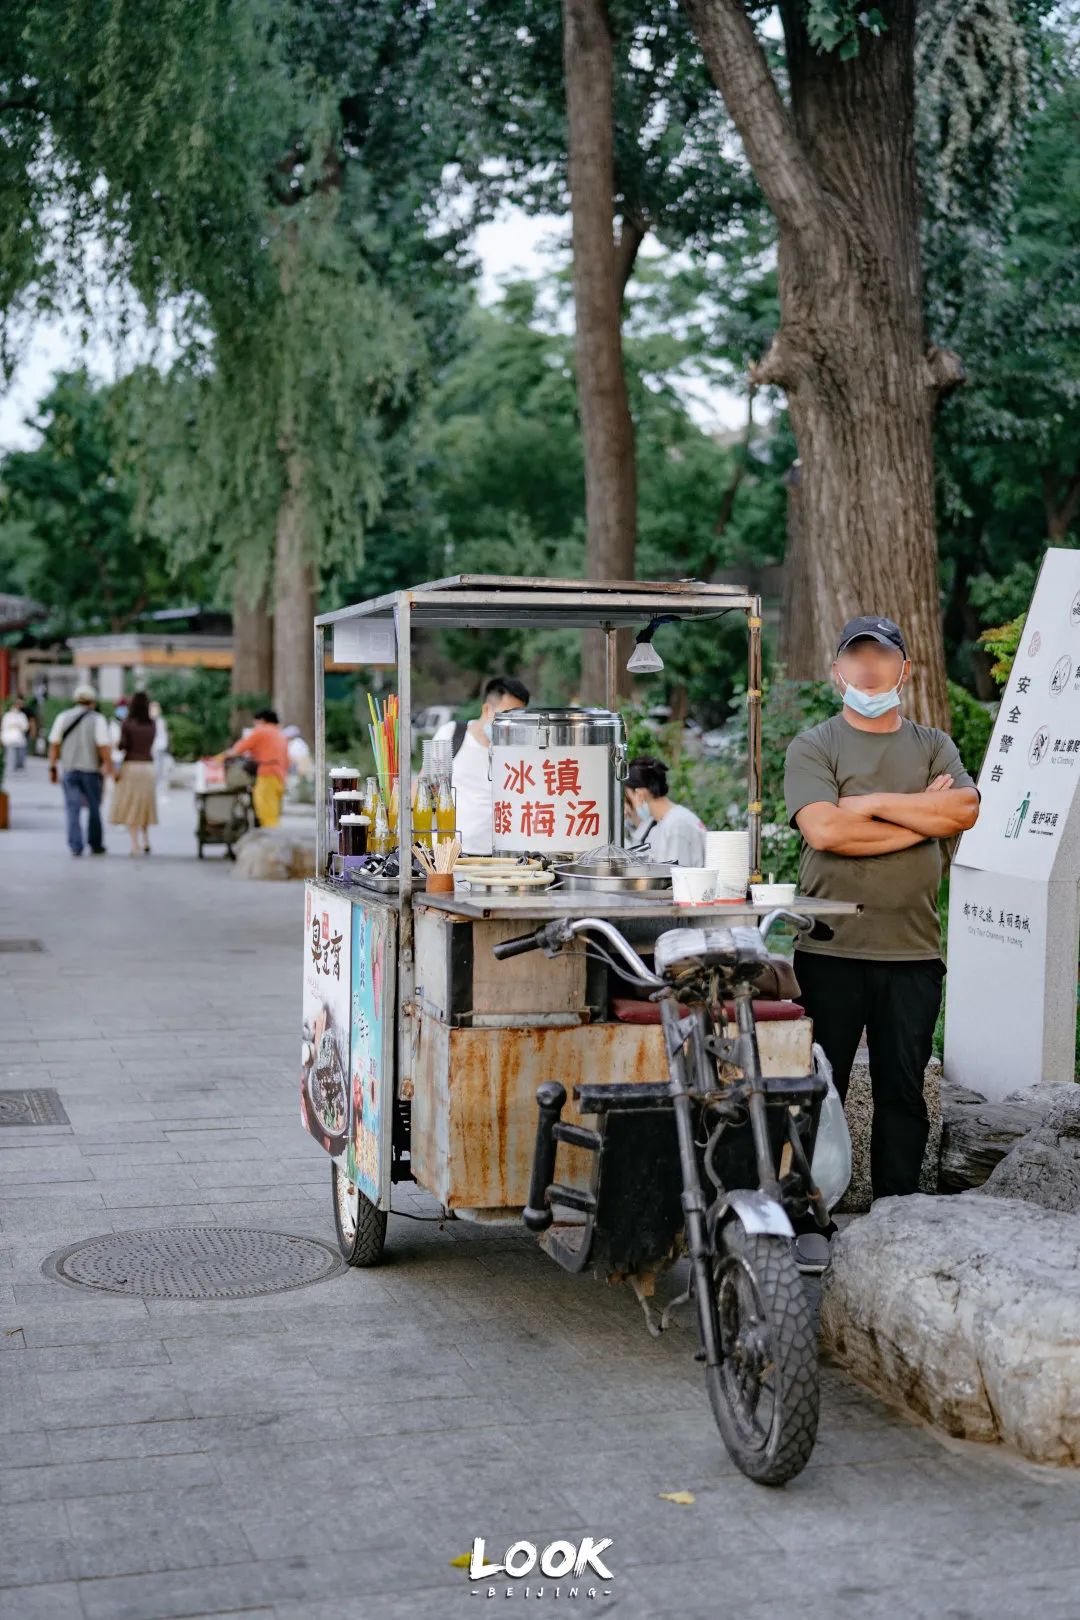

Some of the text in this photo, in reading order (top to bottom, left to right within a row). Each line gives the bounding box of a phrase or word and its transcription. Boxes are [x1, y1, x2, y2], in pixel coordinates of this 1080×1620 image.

[990, 675, 1031, 783] 安全警告
[503, 758, 581, 796] 冰镇
[494, 800, 600, 837] 酸梅汤
[311, 913, 343, 981] 臭豆腐
